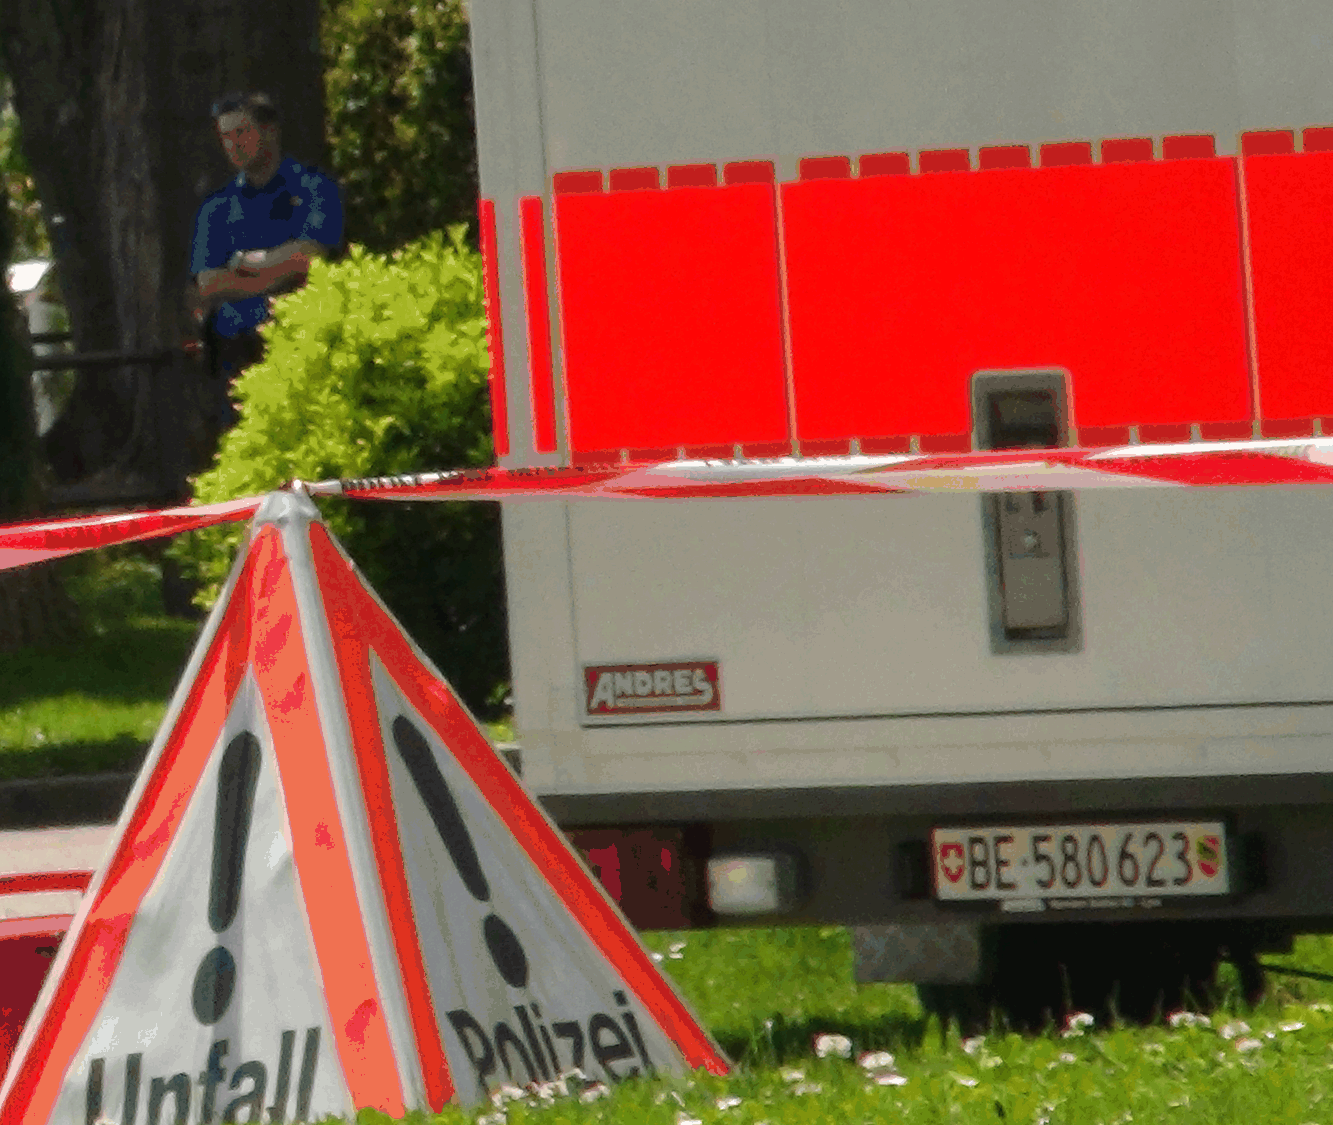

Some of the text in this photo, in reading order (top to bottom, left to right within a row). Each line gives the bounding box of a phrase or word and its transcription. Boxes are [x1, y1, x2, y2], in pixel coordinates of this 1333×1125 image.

[590, 669, 713, 709] ANDRES
[86, 1026, 321, 1125] Unfall
[445, 989, 661, 1098] Polizei
